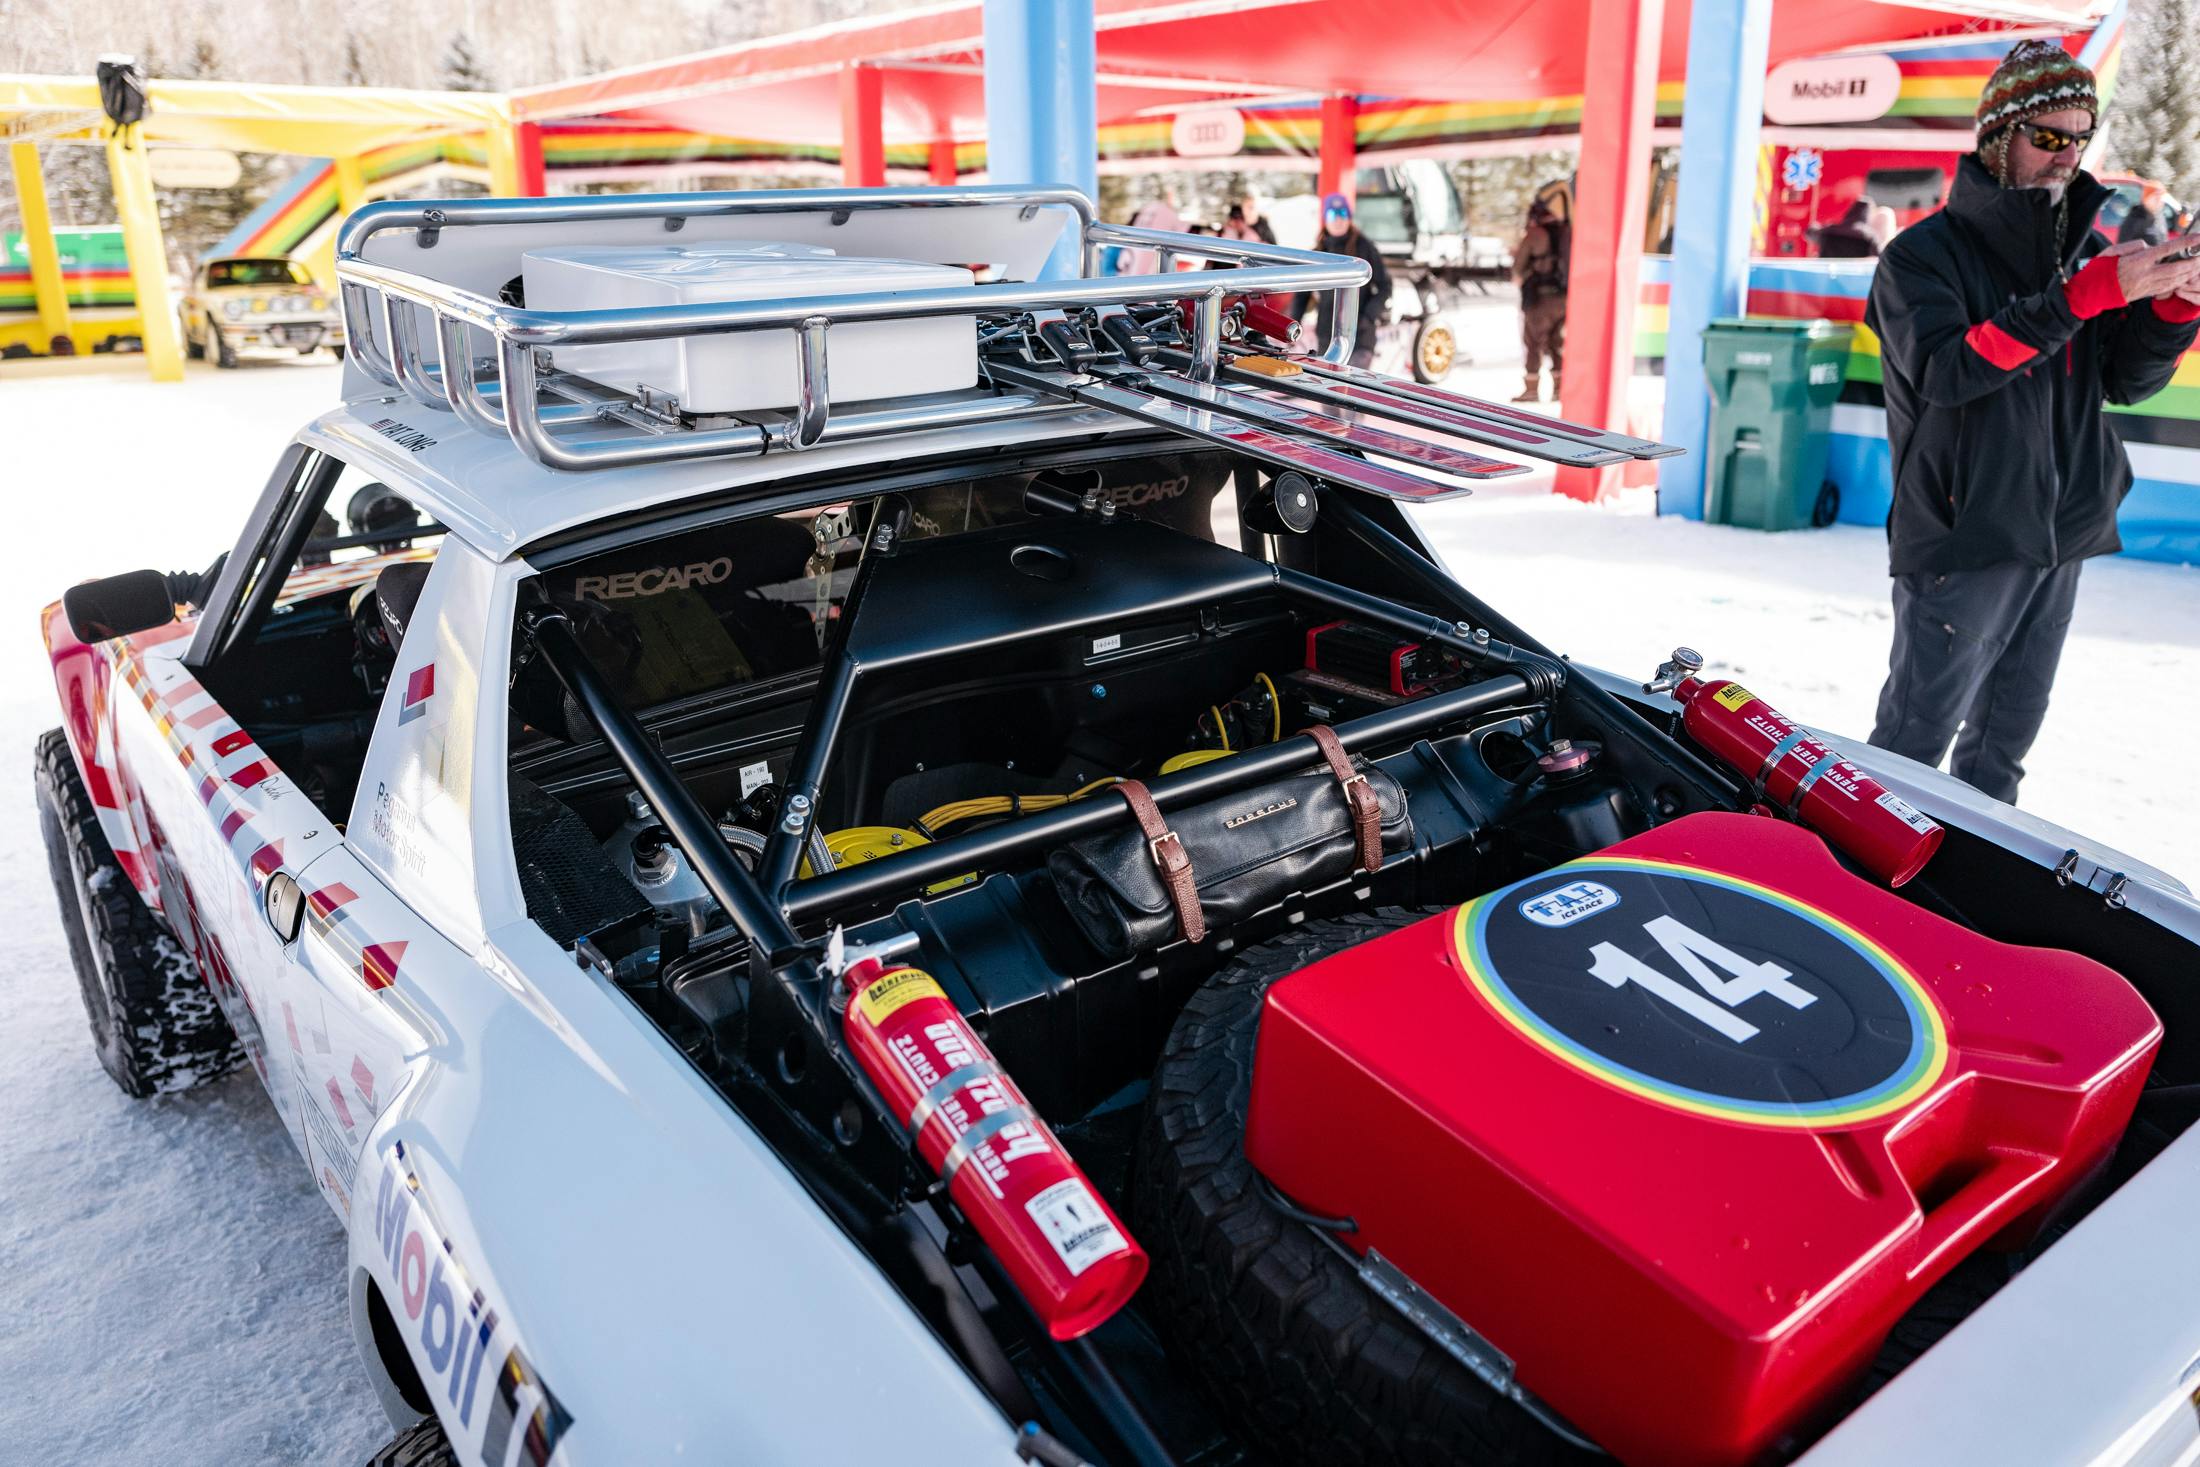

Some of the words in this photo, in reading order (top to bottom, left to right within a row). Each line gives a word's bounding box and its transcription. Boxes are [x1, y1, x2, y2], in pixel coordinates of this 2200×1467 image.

[1792, 80, 1845, 98] Mobil
[394, 431, 438, 452] LONG
[1087, 475, 1189, 507] RECARO
[912, 511, 941, 537] CARO
[575, 556, 733, 601] RECARO
[377, 781, 416, 834] Pegasus
[1226, 798, 1298, 829] PORSCHE
[399, 834, 426, 878] Spirit
[1561, 907, 1578, 920] ICE
[1579, 899, 1604, 913] RACE
[1587, 914, 1819, 1044] 14
[376, 1164, 498, 1431] Mobil
